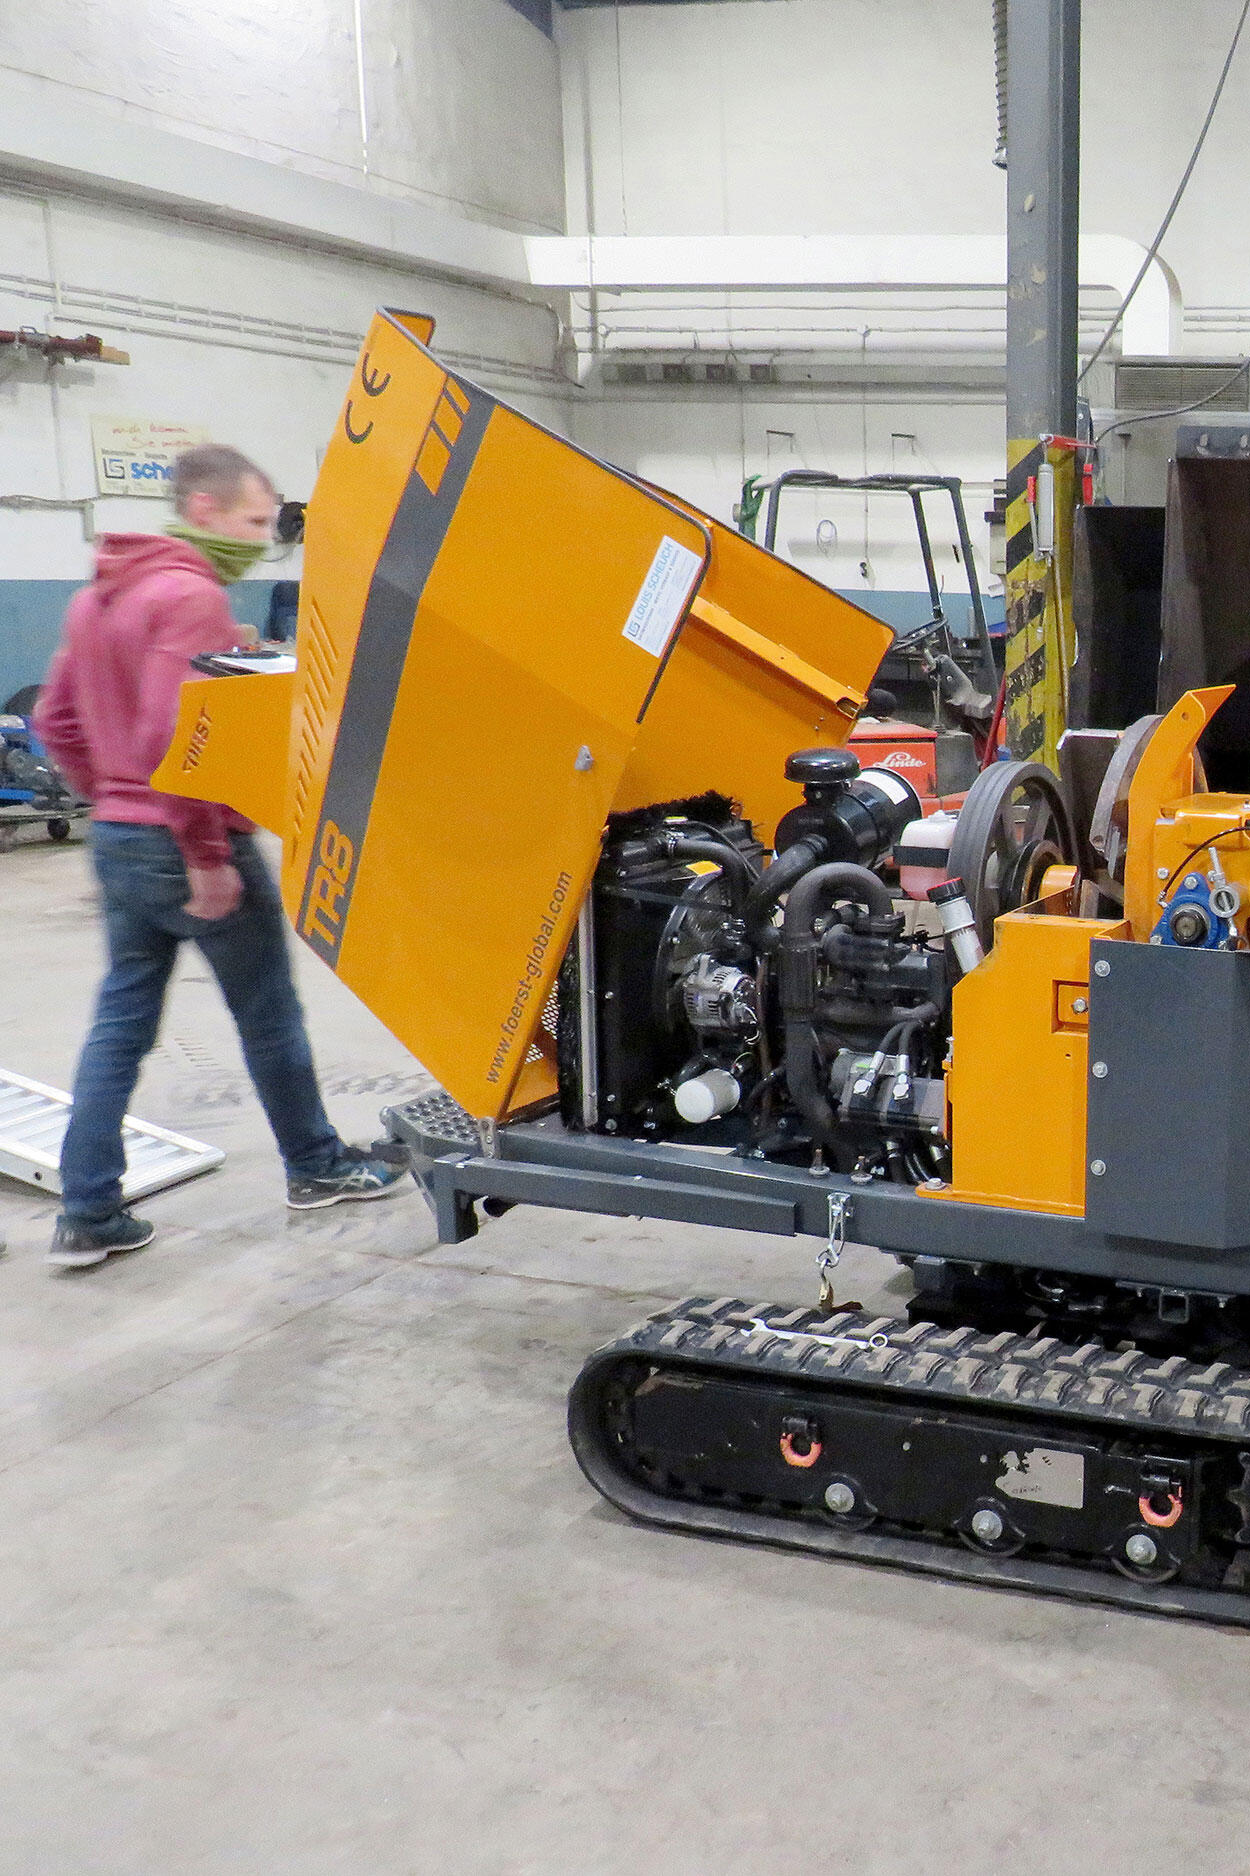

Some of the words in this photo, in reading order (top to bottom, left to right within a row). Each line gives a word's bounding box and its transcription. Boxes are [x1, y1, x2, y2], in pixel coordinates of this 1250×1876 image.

[637, 591, 652, 620] LOUIS
[872, 751, 927, 768] Linde
[303, 820, 354, 946] TR8
[486, 871, 573, 1083] www.foerst-global.com
